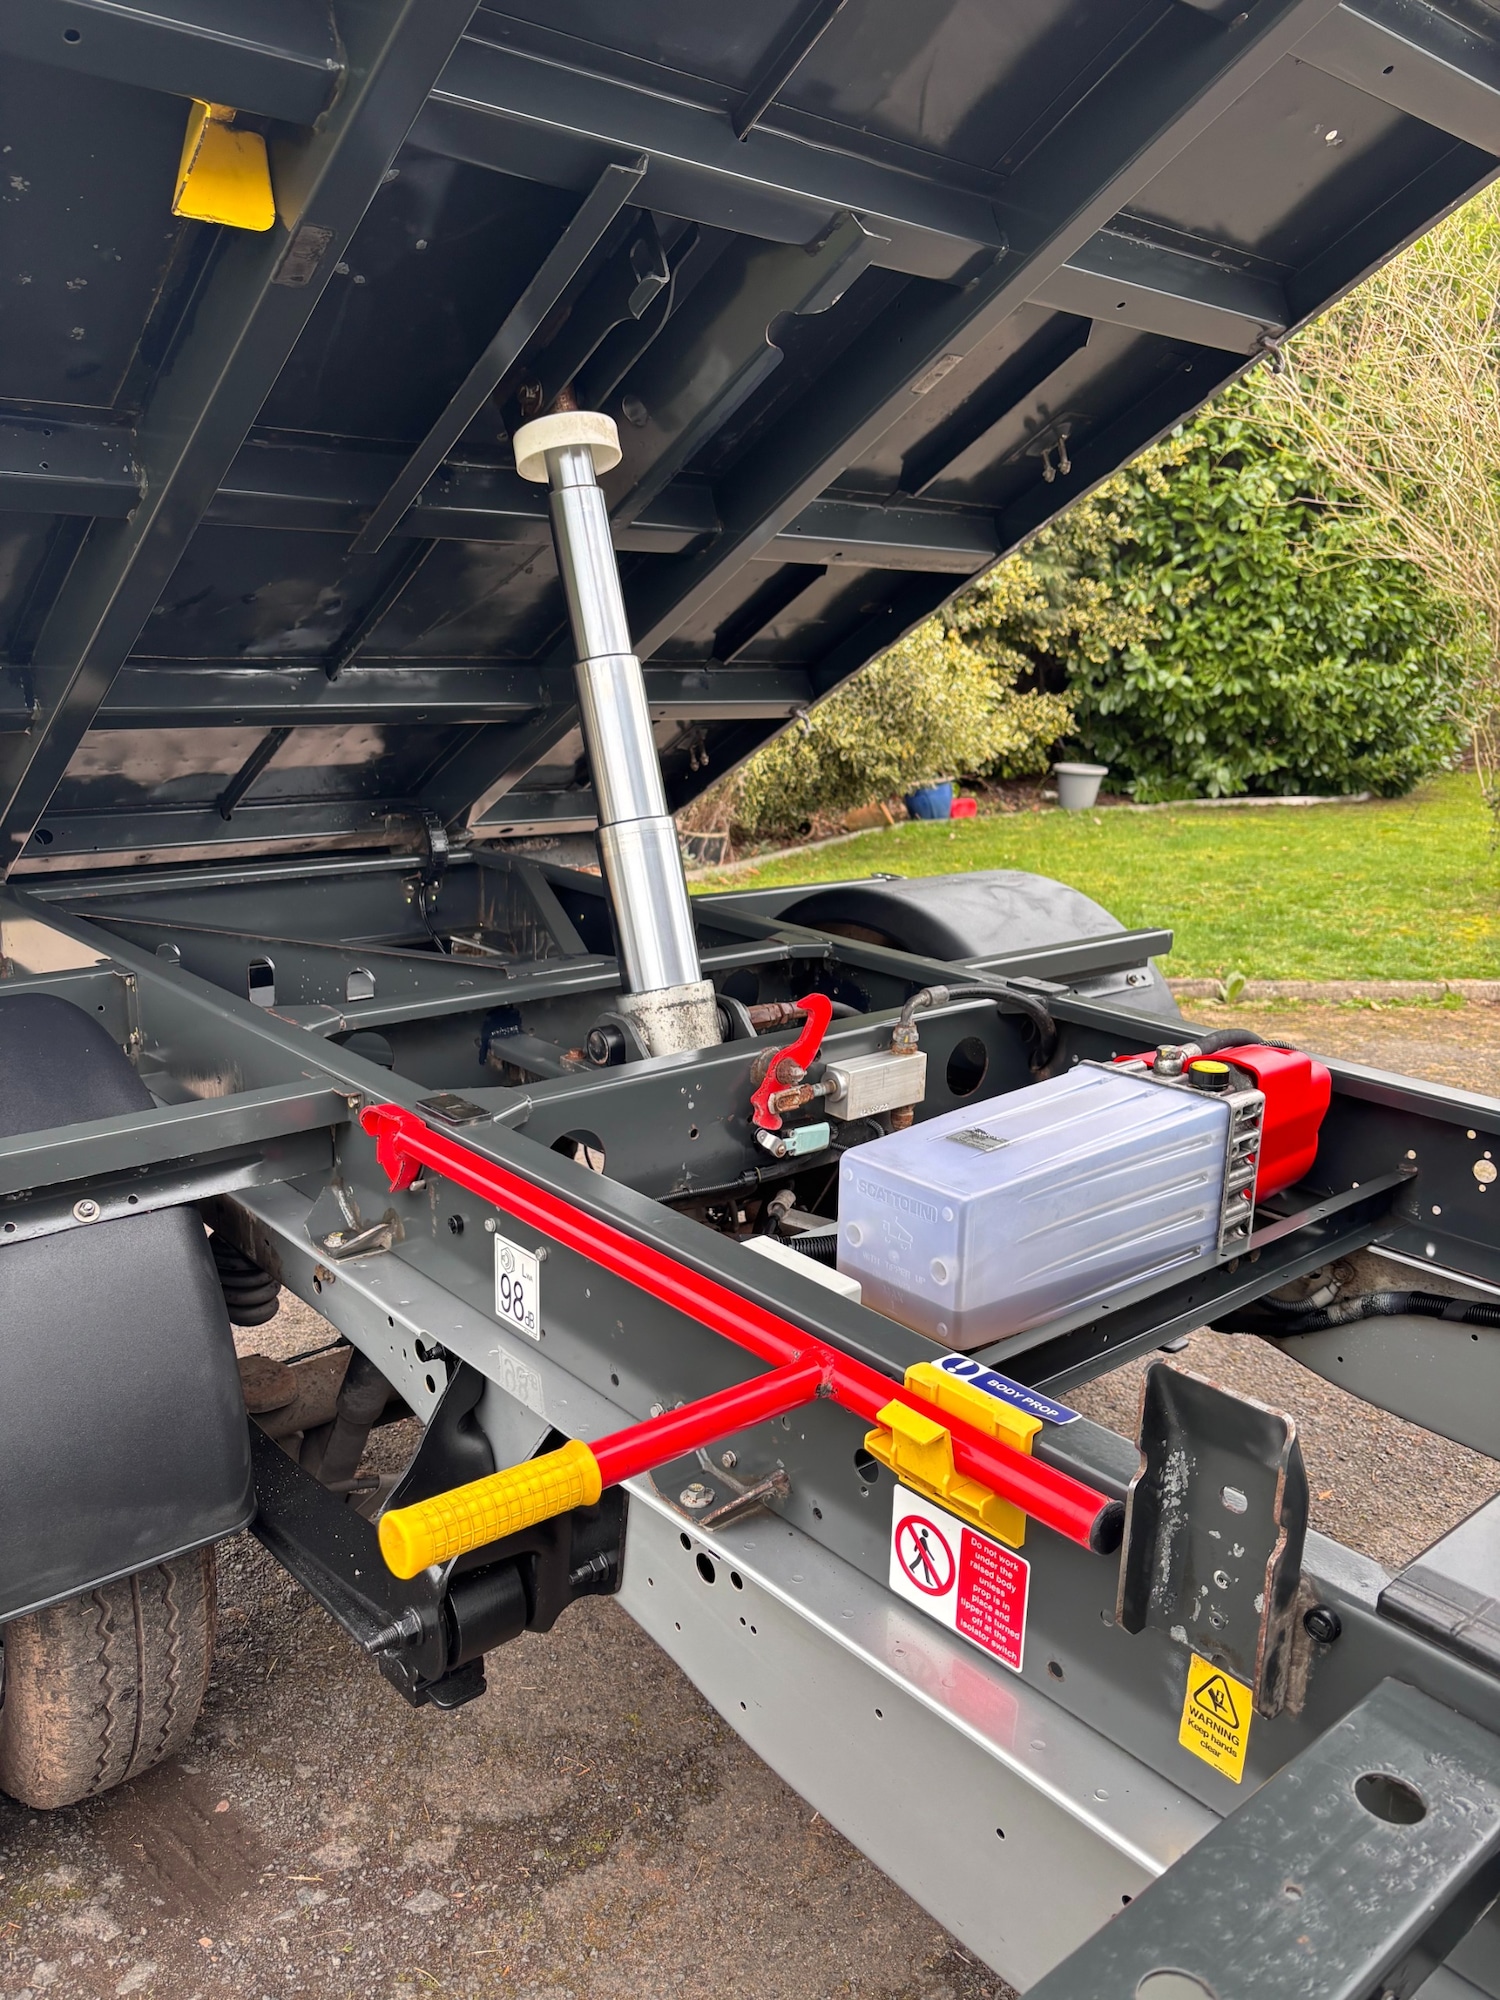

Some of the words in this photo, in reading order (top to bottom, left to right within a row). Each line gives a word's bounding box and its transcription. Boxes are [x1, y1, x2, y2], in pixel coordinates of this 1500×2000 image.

[858, 1180, 936, 1222] SCATTOLINI
[501, 1273, 524, 1322] 98
[525, 1311, 534, 1330] dB
[987, 1379, 1024, 1399] BODY
[1022, 1397, 1059, 1417] PROP
[971, 1537, 982, 1549] Do
[984, 1546, 997, 1558] not
[999, 1555, 1018, 1572] work
[975, 1552, 998, 1570] under
[1000, 1566, 1013, 1579] the
[970, 1560, 994, 1579] raised
[996, 1574, 1016, 1593] body
[979, 1577, 1005, 1597] unless
[972, 1594, 993, 1612] place
[994, 1609, 1010, 1622] and
[973, 1584, 991, 1600] prop
[993, 1595, 1000, 1605] is
[1002, 1601, 1010, 1612] in
[961, 1597, 983, 1616] tipper
[985, 1612, 992, 1622] is
[994, 1618, 1020, 1640] turned
[972, 1617, 983, 1627] off
[984, 1624, 992, 1633] at
[994, 1629, 1007, 1643] the
[961, 1618, 990, 1642] isolator
[991, 1640, 1017, 1661] switch
[1188, 1718, 1209, 1738] Keep
[1211, 1734, 1237, 1757] hands
[1189, 1705, 1239, 1746] WARNING
[1200, 1740, 1221, 1758] clear
